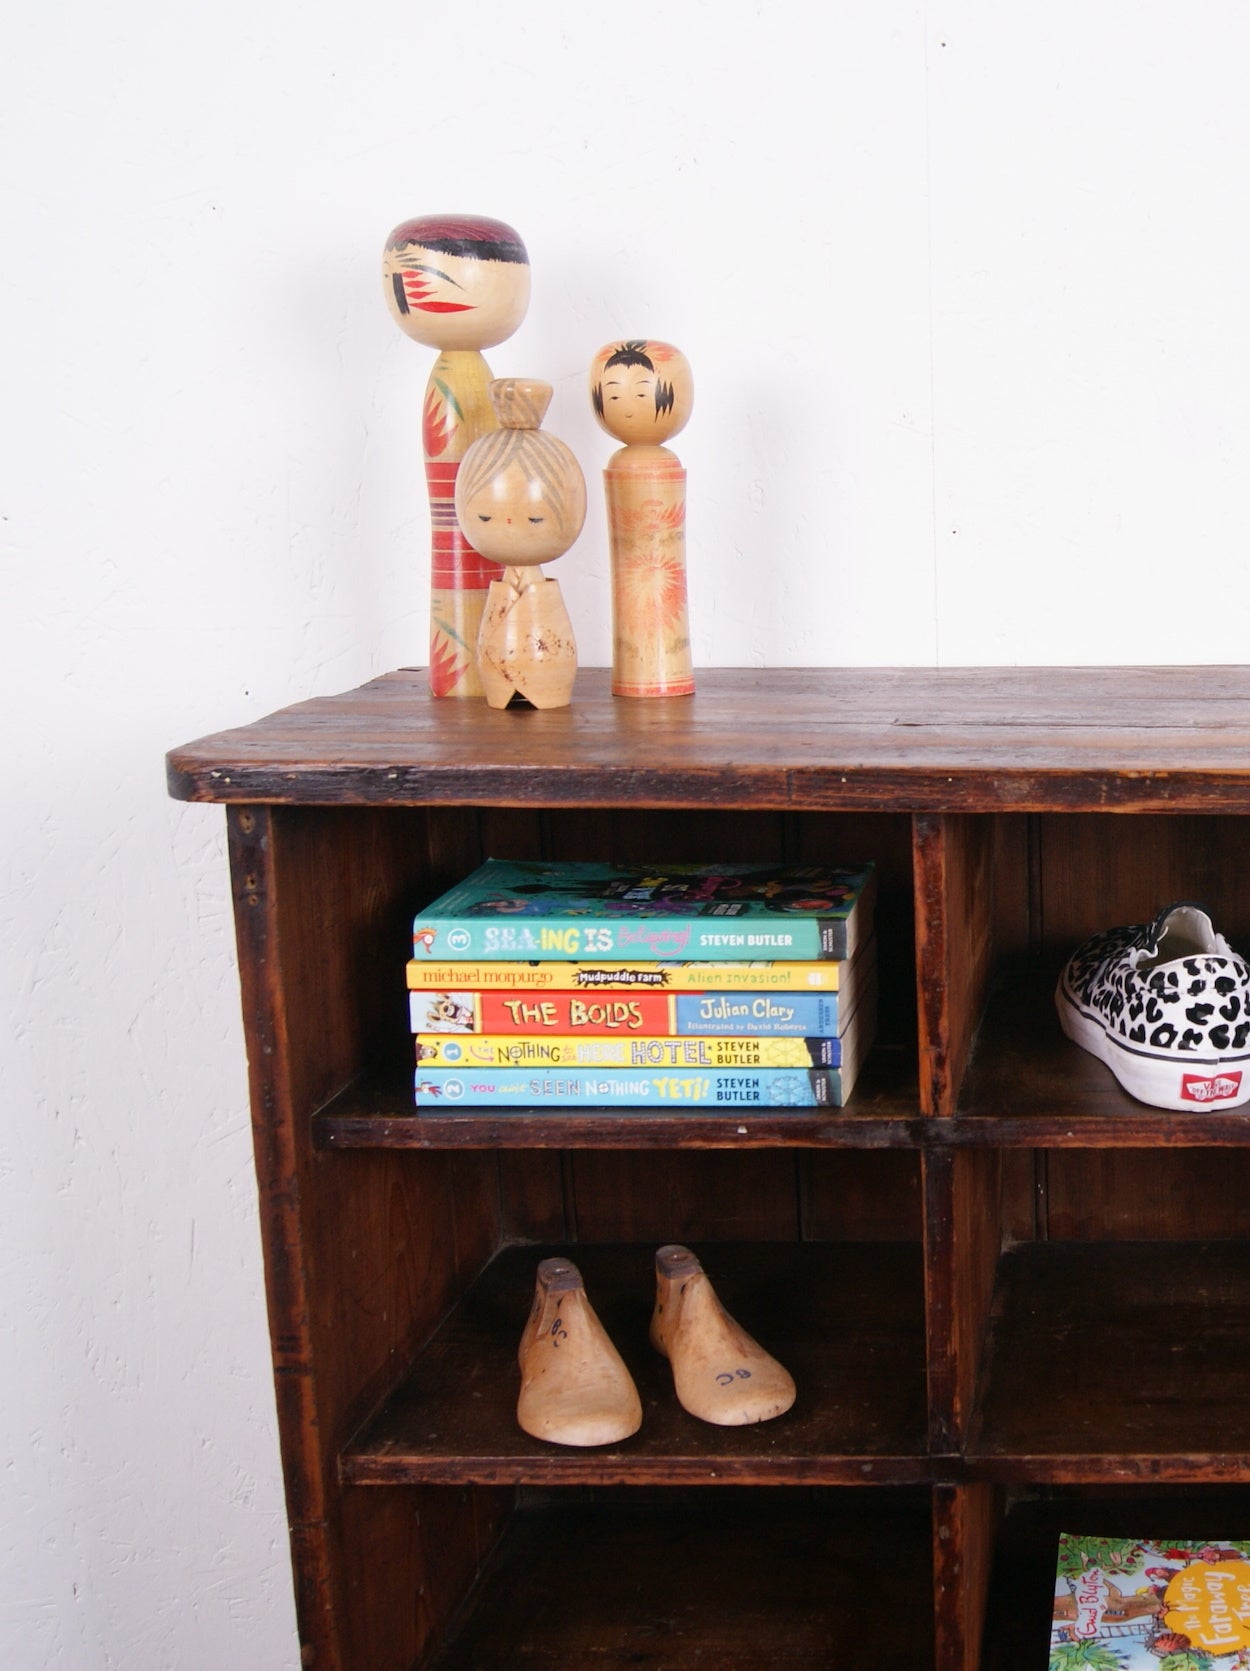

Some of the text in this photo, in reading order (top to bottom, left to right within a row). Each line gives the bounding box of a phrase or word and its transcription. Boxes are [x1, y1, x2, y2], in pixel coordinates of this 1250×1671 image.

[584, 927, 614, 953] IS
[700, 934, 793, 947] STEVEN BUTLER
[423, 968, 554, 987] michael morpurgo
[579, 972, 636, 984] Mudpuddle
[688, 971, 792, 984] Alien Invasion!
[503, 998, 644, 1030] THE BOLDS
[700, 996, 796, 1022] Julian Clary
[687, 1021, 734, 1031] Illustrated
[735, 1024, 745, 1032] by
[746, 1021, 772, 1031] David
[497, 1041, 561, 1064] NOTHING
[576, 1042, 626, 1063] HERE
[630, 1040, 712, 1065] HOTEL
[717, 1041, 760, 1052] STEVEN
[717, 1054, 761, 1065] BUTLER
[471, 1084, 496, 1093] YOU
[529, 1079, 582, 1096] SEEN
[584, 1079, 649, 1097] NOTHING
[717, 1078, 760, 1089] STEVEN
[717, 1091, 760, 1101] BUTLER
[1079, 1567, 1100, 1604] Blyton
[1178, 1576, 1201, 1612] Magic
[1199, 1570, 1241, 1646] Faraway
